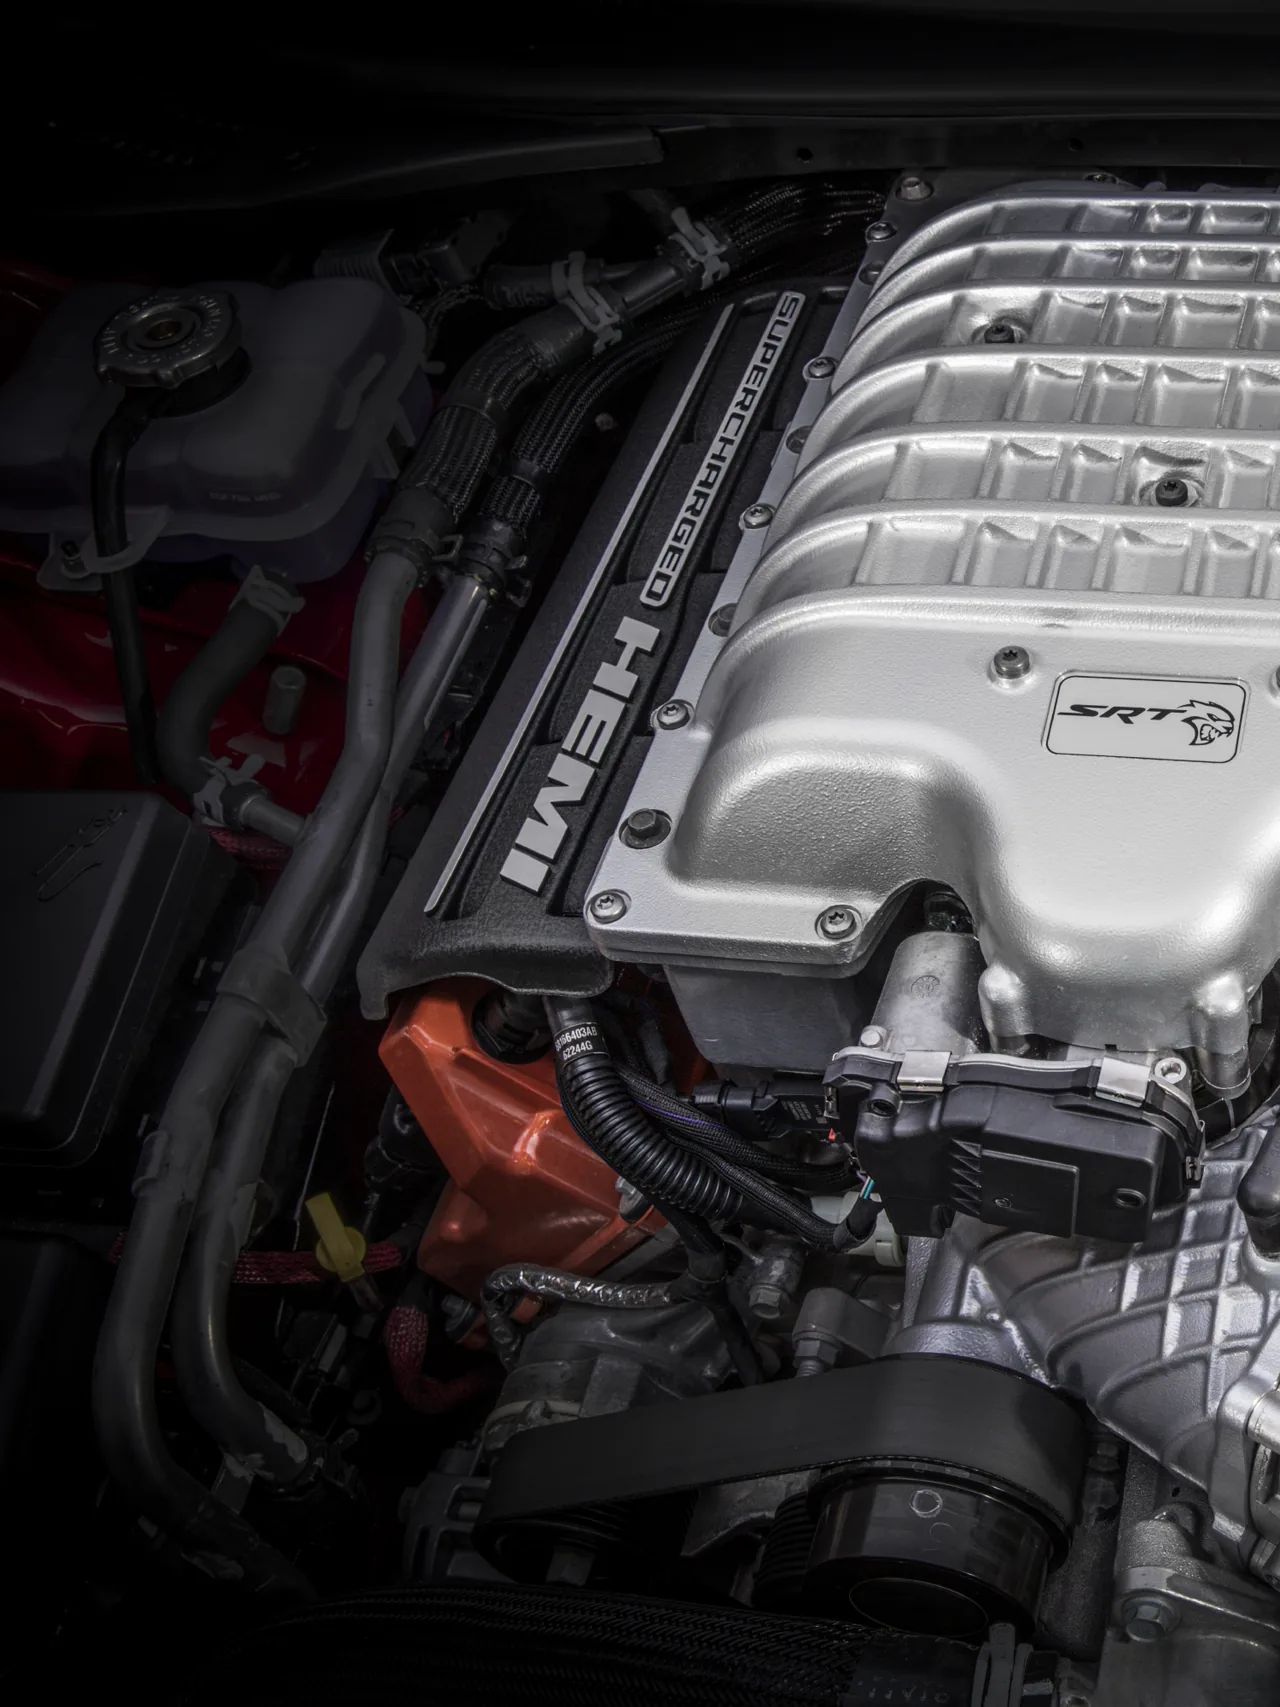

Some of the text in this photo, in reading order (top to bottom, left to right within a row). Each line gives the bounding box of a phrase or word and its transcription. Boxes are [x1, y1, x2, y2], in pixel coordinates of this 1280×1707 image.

[500, 294, 800, 892] SUPERCHARGED HEMI
[1057, 704, 1188, 725] SRT
[562, 1040, 594, 1060] 62244G
